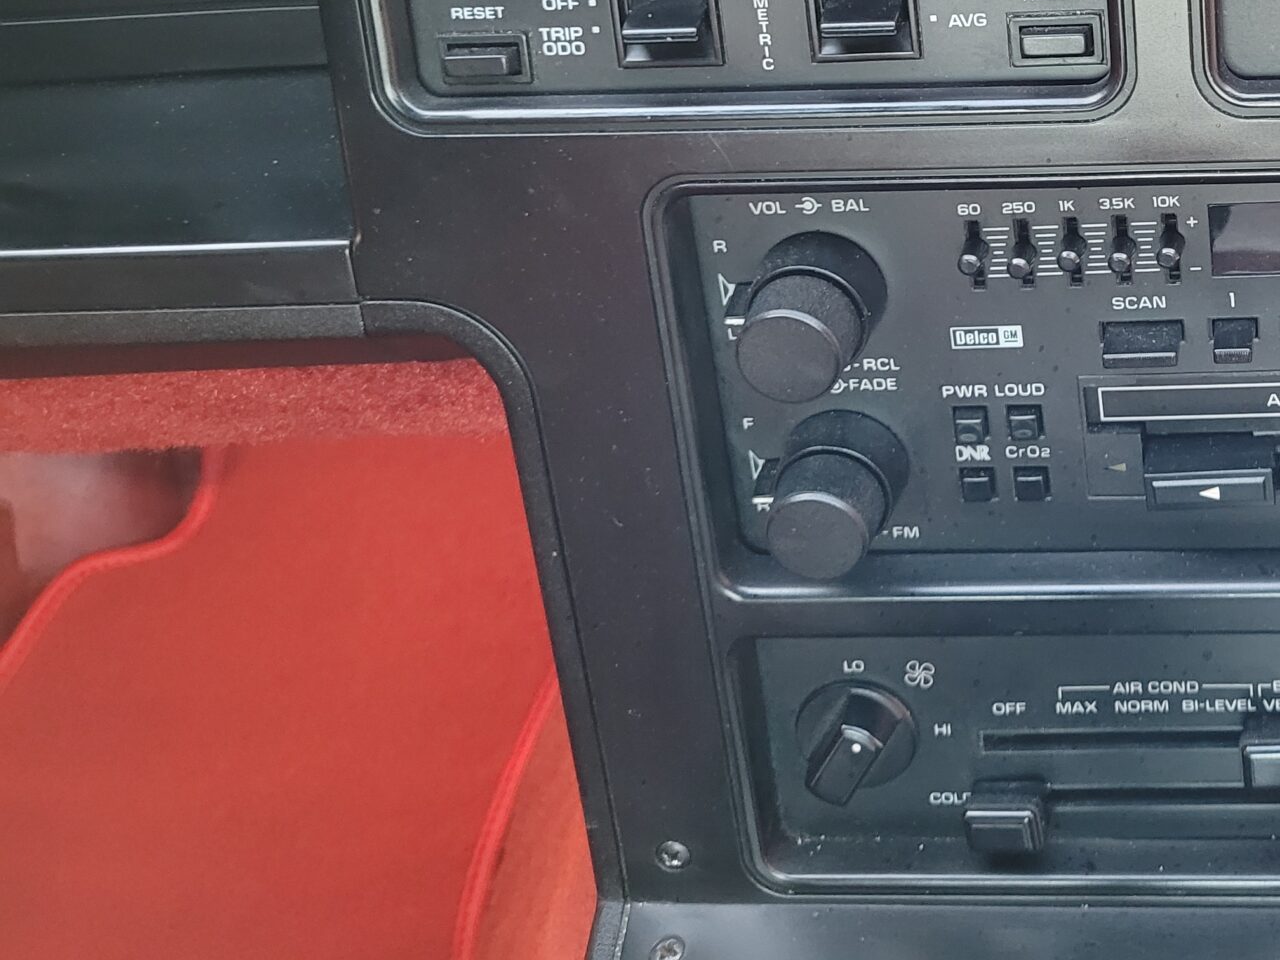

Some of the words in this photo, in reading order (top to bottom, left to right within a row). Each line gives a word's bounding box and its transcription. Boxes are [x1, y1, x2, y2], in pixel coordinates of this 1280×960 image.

[450, 6, 504, 21] RESET
[948, 12, 987, 28] AVG
[538, 27, 583, 42] TRIP
[542, 40, 586, 56] ODO
[749, 201, 787, 215] VOL
[831, 199, 870, 212] BAL
[957, 204, 981, 216] 60
[1002, 202, 1036, 214] 250
[1059, 200, 1076, 212] 1K
[1099, 198, 1136, 210] 3.5K
[1152, 196, 1181, 208] 10K
[712, 240, 727, 253] R
[1111, 296, 1167, 310] SCAN
[1228, 292, 1236, 308] 1
[955, 330, 998, 346] Delco
[1003, 329, 1018, 340] GM
[849, 378, 898, 391] FADE
[942, 384, 988, 399] PWR
[995, 383, 1045, 397] LOUD
[742, 417, 754, 430] F
[1005, 446, 1051, 458] CrO2
[843, 660, 865, 673] LO
[1112, 682, 1143, 694] AIR
[1148, 681, 1199, 693] COND
[992, 702, 1026, 715] OFF
[1056, 701, 1097, 714] MAX
[1114, 700, 1169, 713] NORM
[1182, 699, 1256, 712] BI-LEVEL
[934, 723, 951, 736] HI
